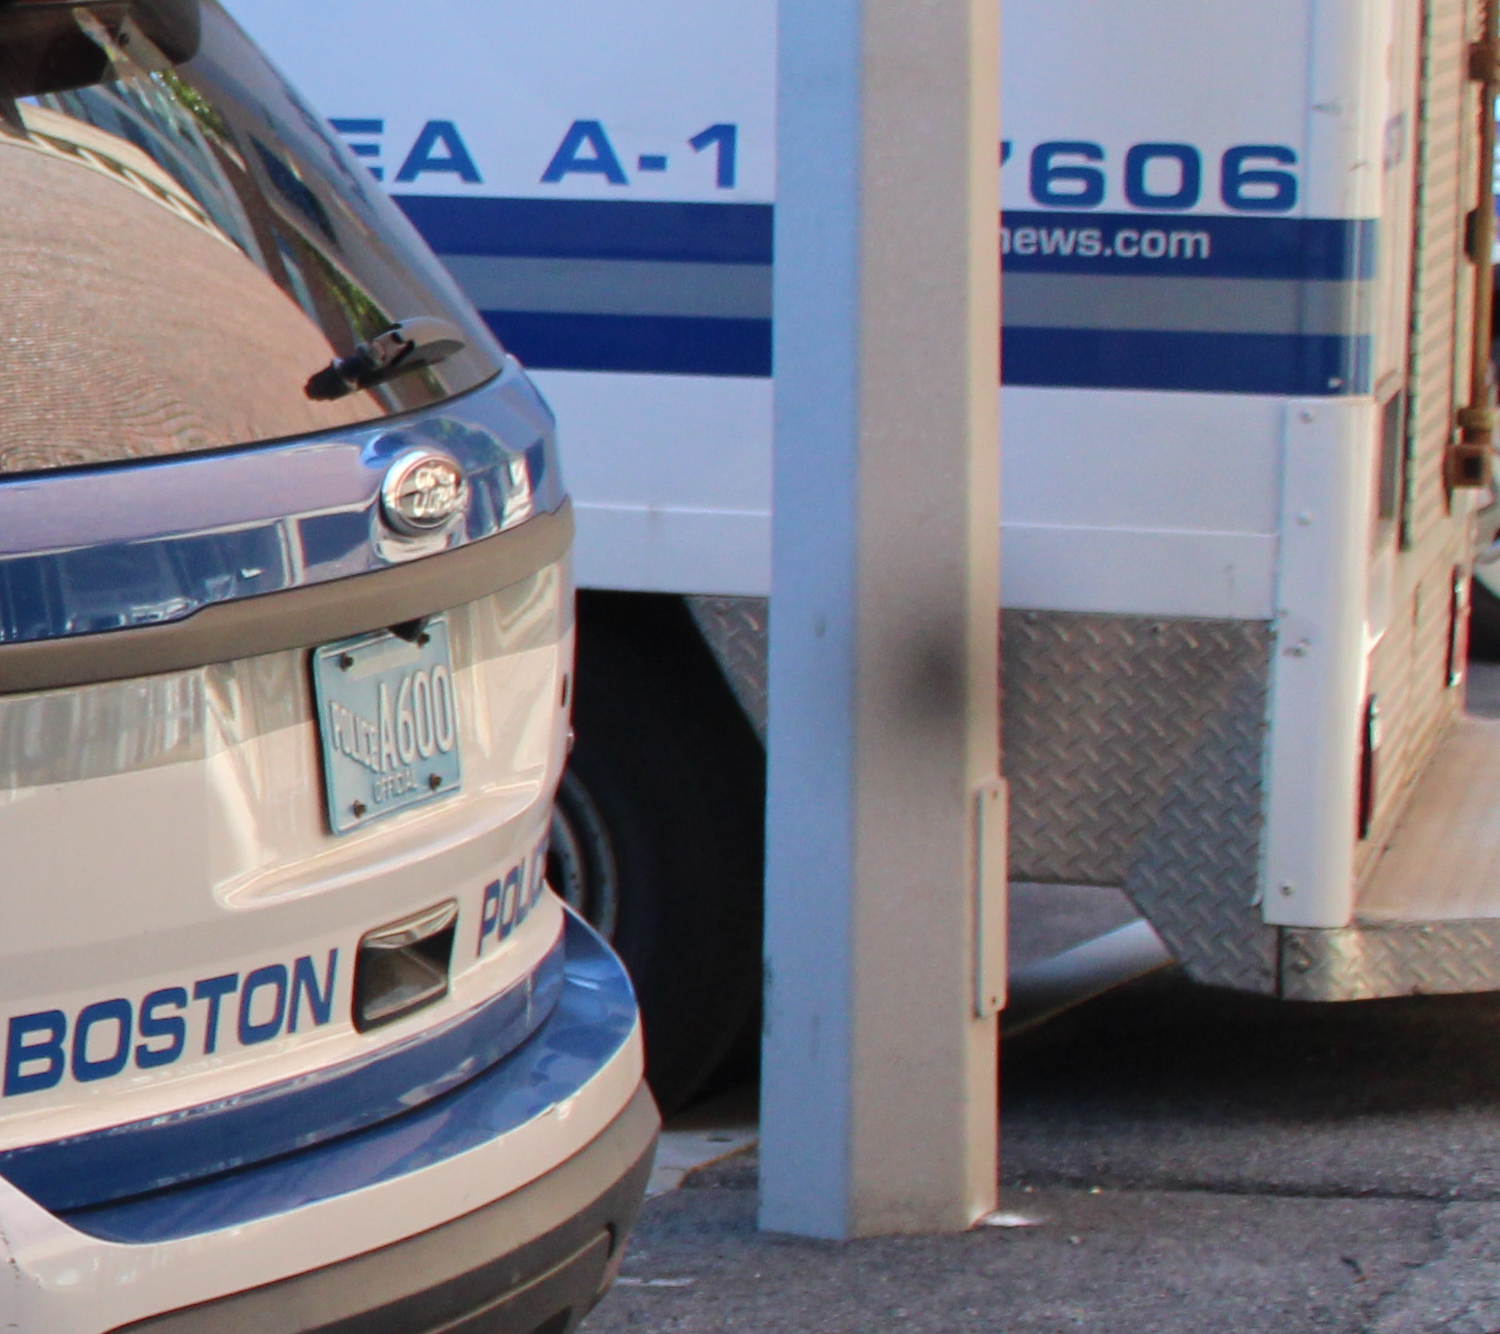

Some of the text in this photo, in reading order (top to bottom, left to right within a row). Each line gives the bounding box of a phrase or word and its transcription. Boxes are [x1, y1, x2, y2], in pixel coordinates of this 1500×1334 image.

[538, 118, 740, 190] A-1
[1000, 139, 1300, 213] 606
[2, 946, 340, 1098] BOSTON
